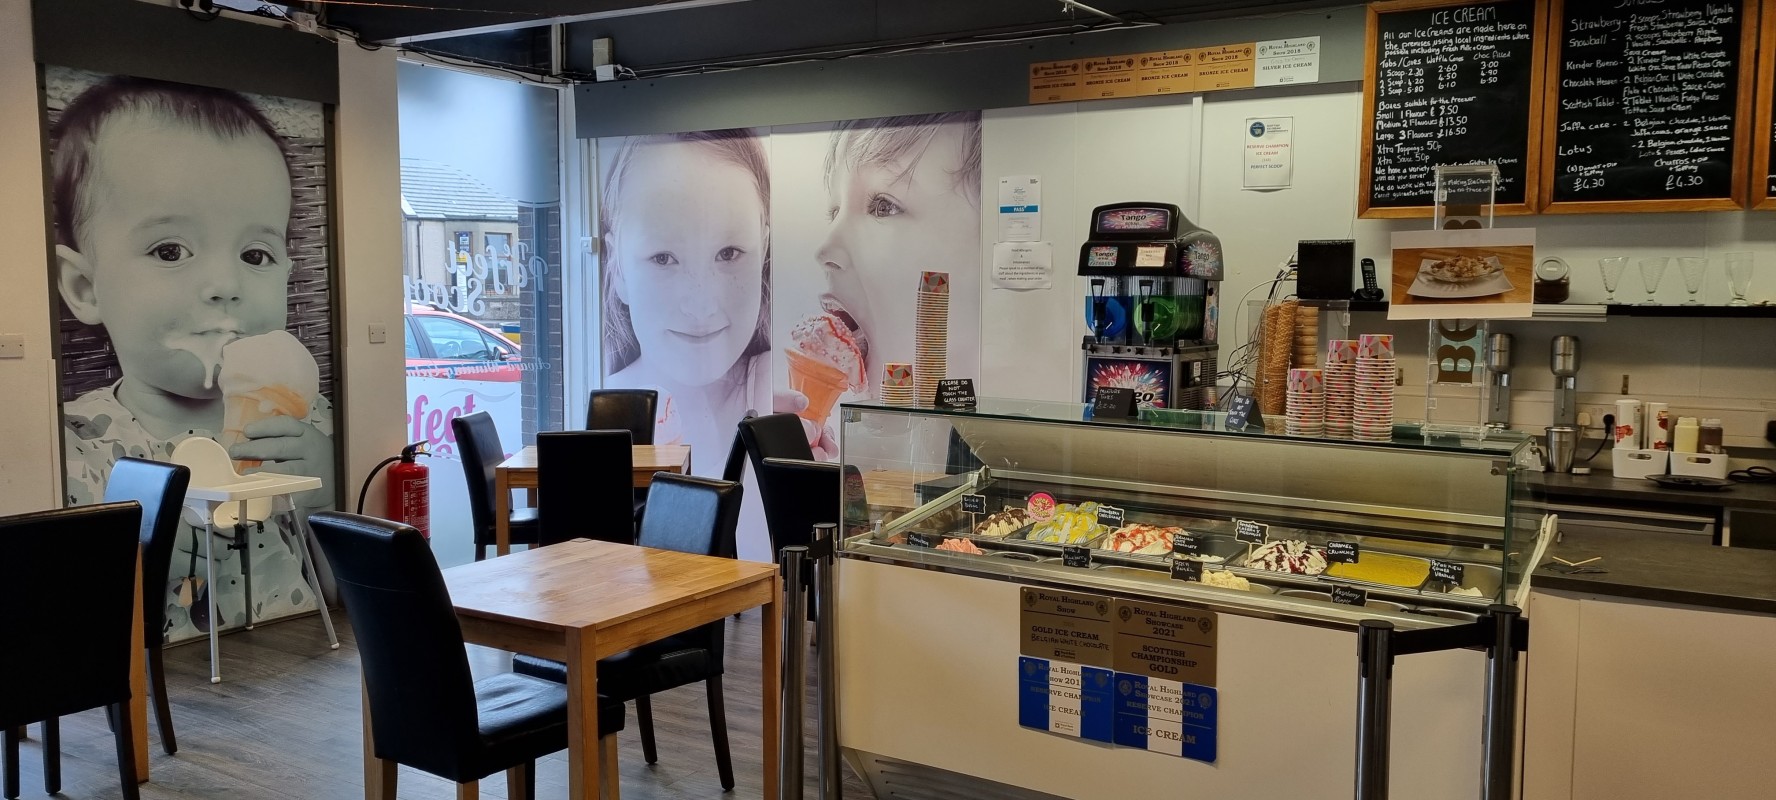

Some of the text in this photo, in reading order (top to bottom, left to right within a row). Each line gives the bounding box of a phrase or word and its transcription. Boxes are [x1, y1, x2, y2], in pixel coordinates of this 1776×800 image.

[1432, 7, 1496, 25] ICE CREAM
[1570, 16, 1621, 32] Strawberry
[1384, 31, 1394, 40] All
[1456, 27, 1470, 35] are
[1473, 25, 1495, 34] made
[1497, 21, 1516, 31] here
[1385, 32, 1530, 51] the premises using local ingredients where
[1569, 34, 1607, 47] Snowball
[1410, 47, 1440, 55] including
[1596, 59, 1619, 68] Bueno
[1386, 69, 1406, 80] Scoop
[1387, 78, 1404, 87] Scoop
[1387, 87, 1403, 96] Scoop
[1562, 98, 1592, 110] Scottish
[1376, 109, 1428, 120] Small Flavour
[1376, 120, 1401, 130] Medium
[1560, 118, 1666, 132] Jaffa Belgian
[1674, 126, 1702, 136] orange
[1376, 131, 1394, 141] Large
[1407, 129, 1434, 139] Flavours
[1376, 140, 1443, 156] Xtra Toppings 50p
[1558, 144, 1592, 156] Lotus
[1377, 153, 1430, 166] Xtra Sauce 50p
[1654, 157, 1690, 167] Churros
[1408, 165, 1430, 174] variety
[1120, 214, 1147, 222] Tango
[1194, 251, 1210, 262] Tango
[1328, 542, 1353, 550] CARAMEL
[1039, 593, 1095, 607] ROYAL HIGHLAND
[1056, 605, 1076, 614] SHOW
[1134, 607, 1196, 623] ROYAL HIGHLAND
[1145, 618, 1184, 630] SHOWCASE
[1032, 625, 1099, 641] GOLD ICE CREAM
[1153, 627, 1176, 637] 2021
[1060, 638, 1078, 647] WHITE
[1142, 645, 1186, 658] SCOTTISH
[1131, 652, 1197, 668] CHAMPIONSHIP
[1038, 663, 1092, 679] ROYAL HIGHLAND
[1149, 664, 1178, 675] GOLD
[1045, 674, 1063, 684] SHOW
[1134, 681, 1197, 698] ROYAL HIGHLAND
[1135, 690, 1196, 707] SHOWCASE 2021
[1043, 704, 1086, 717] ICE CREAM
[1126, 700, 1204, 720] RESERVE CHAMPION
[1133, 725, 1196, 745] ICE CREAM
